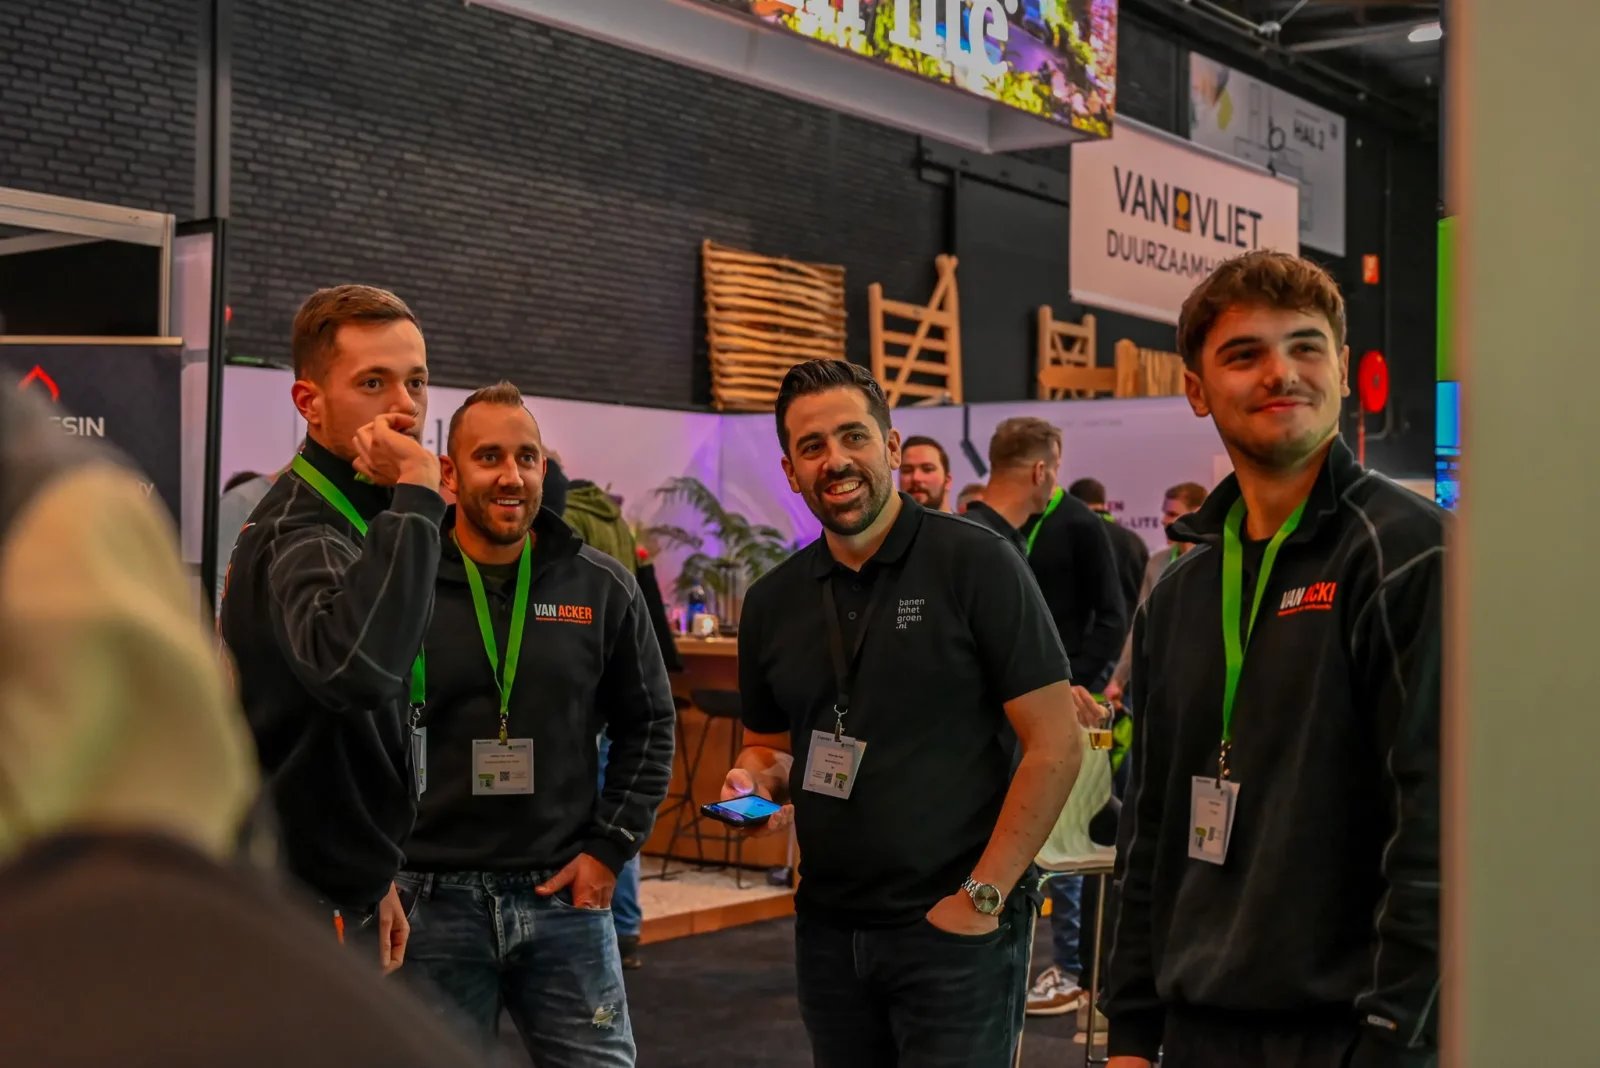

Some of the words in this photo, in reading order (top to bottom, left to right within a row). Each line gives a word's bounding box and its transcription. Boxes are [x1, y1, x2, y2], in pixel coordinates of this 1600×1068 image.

[1113, 165, 1170, 226] VAN
[1195, 193, 1263, 249] VLIET
[899, 598, 925, 606] banen
[533, 603, 557, 617] VAN
[558, 604, 593, 620] ACKER
[897, 606, 920, 614] inhet
[896, 614, 922, 624] groen
